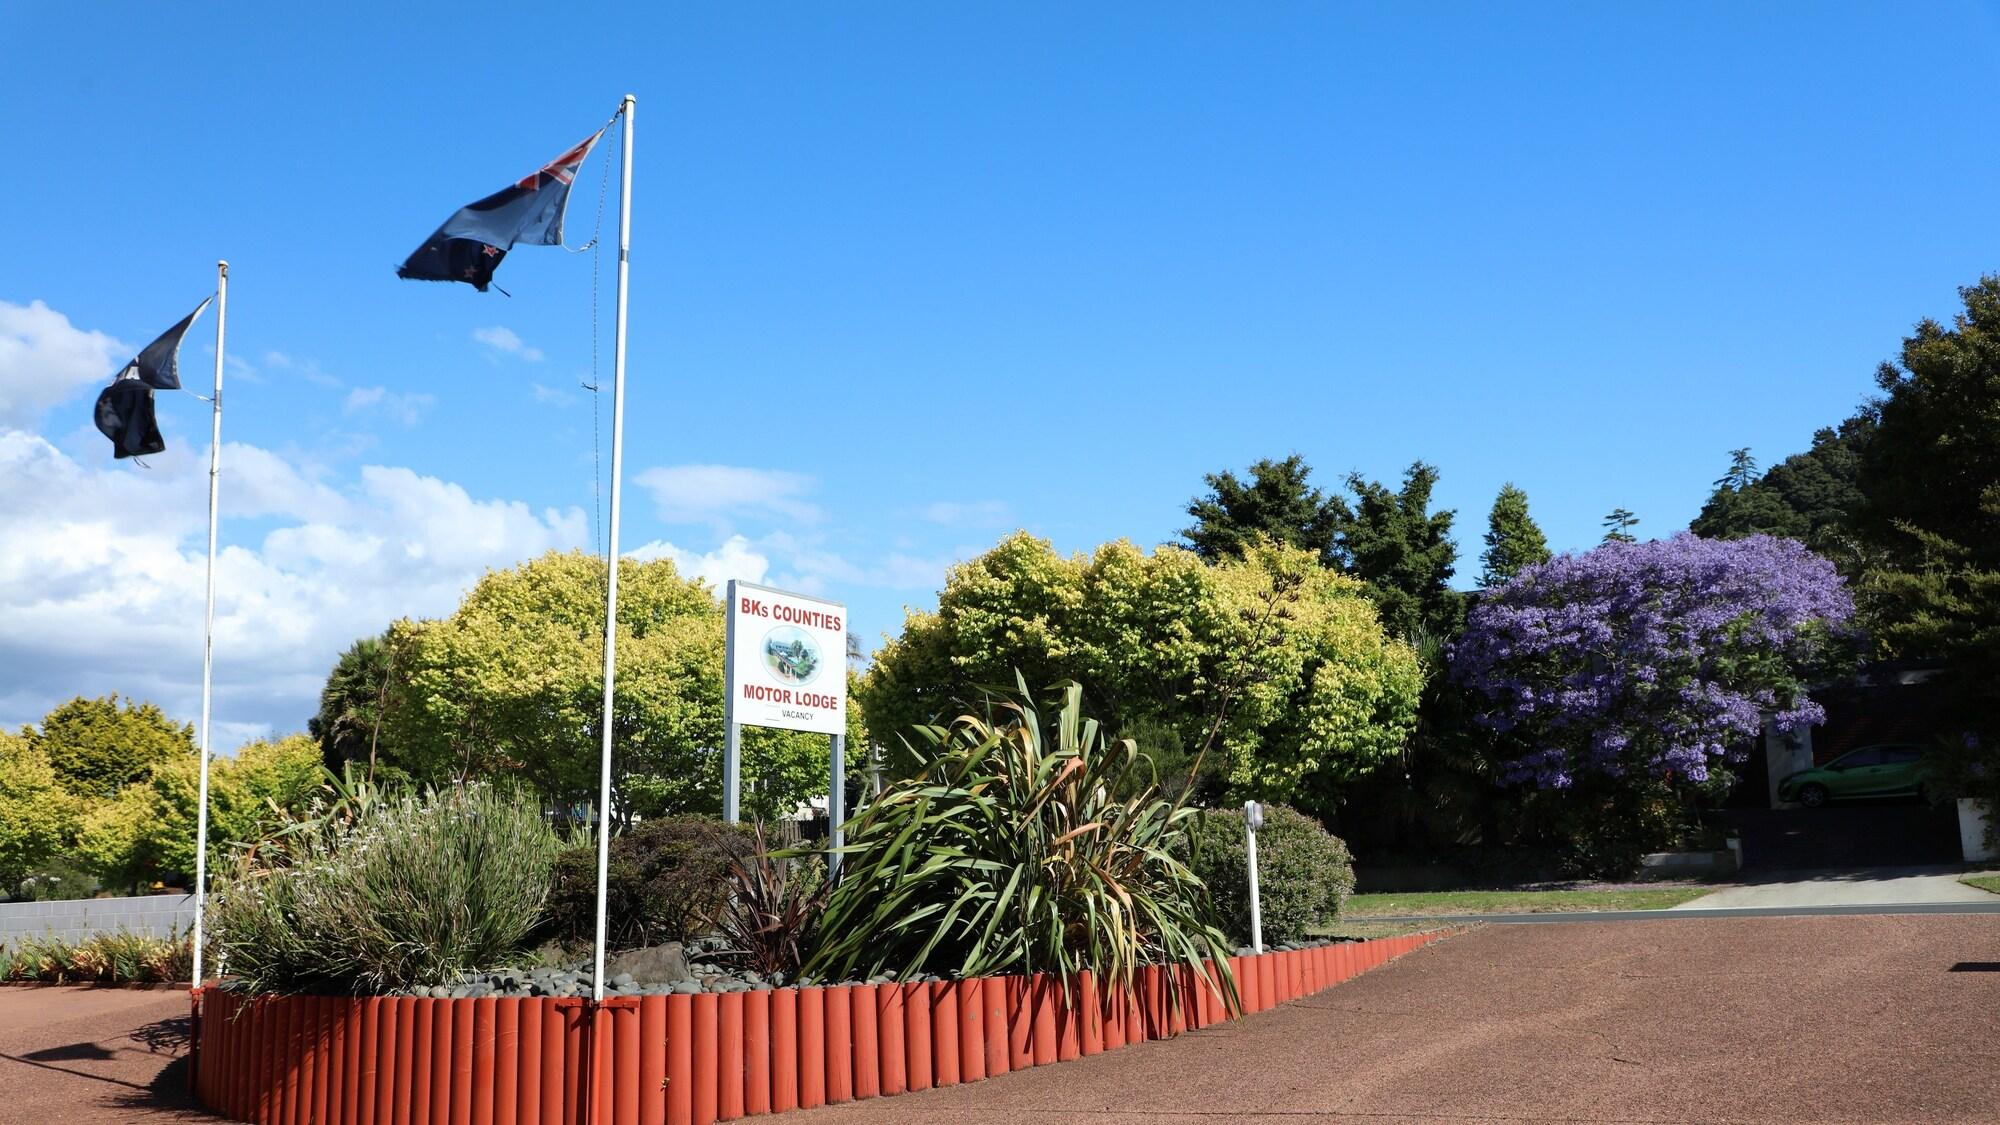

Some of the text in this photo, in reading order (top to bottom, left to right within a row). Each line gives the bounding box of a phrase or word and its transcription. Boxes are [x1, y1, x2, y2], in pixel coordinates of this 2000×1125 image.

[741, 597, 841, 631] BKs COUNTIES
[743, 684, 837, 710] MOTOR LODGE
[782, 709, 814, 721] VACANCY
